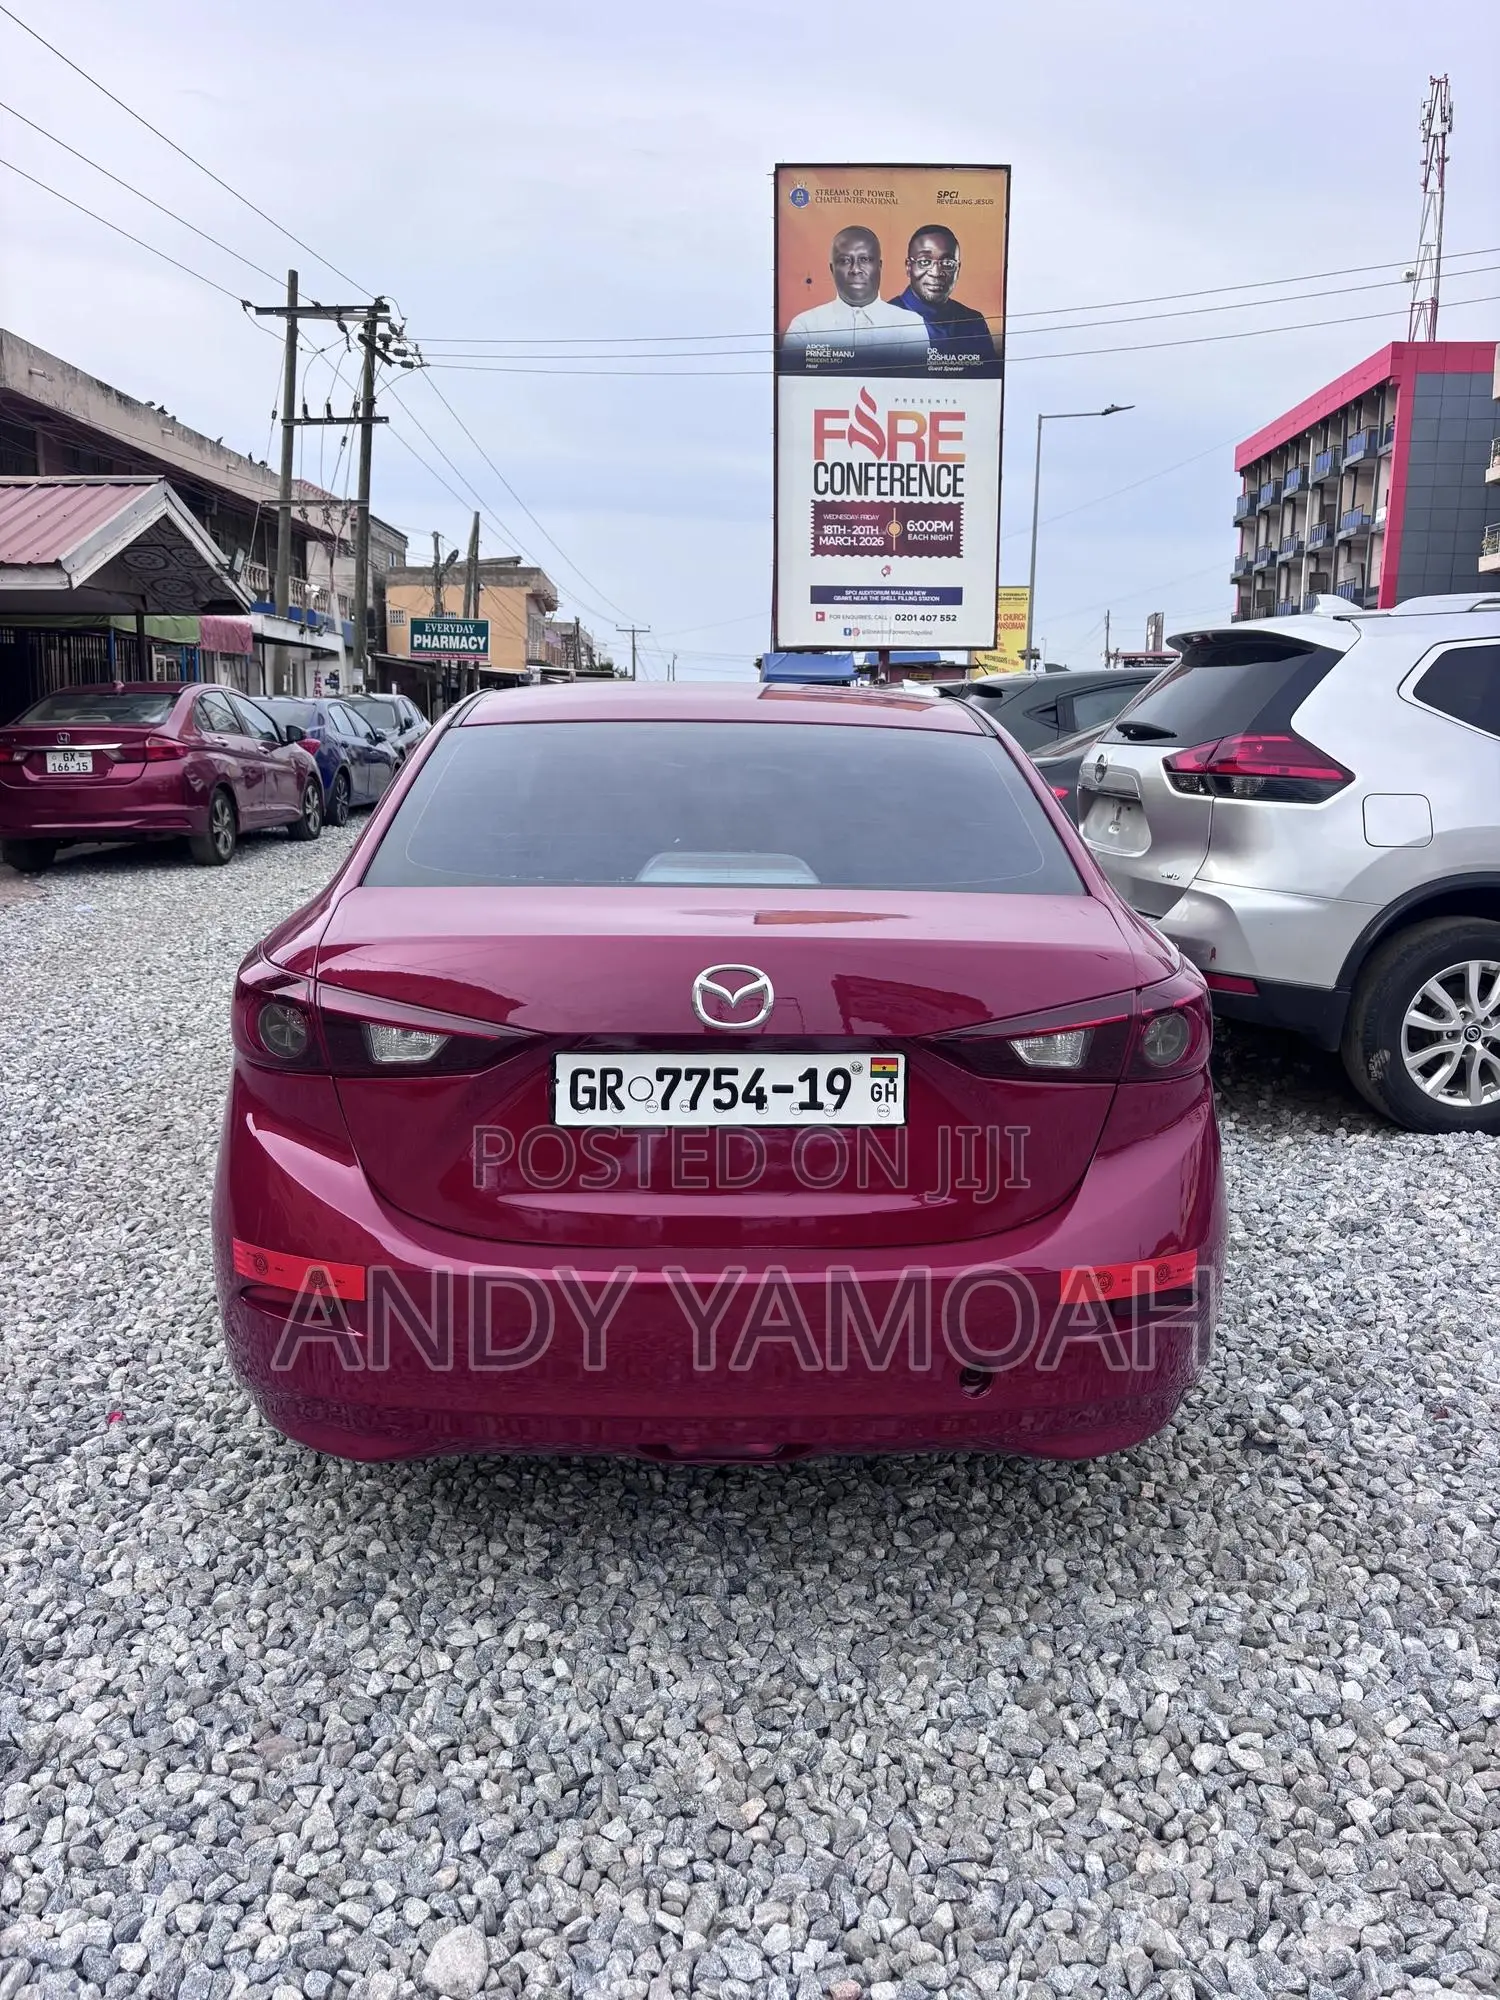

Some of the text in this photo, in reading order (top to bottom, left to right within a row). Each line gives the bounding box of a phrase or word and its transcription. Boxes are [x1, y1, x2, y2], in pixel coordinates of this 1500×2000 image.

[937, 190, 959, 198] SPCI
[844, 197, 898, 205] INTERNATIONAL
[806, 350, 855, 358] PRINCE MANU
[813, 461, 965, 498] CONFERENCE
[906, 520, 954, 533] 6:00PM
[859, 536, 885, 546] 2026
[907, 533, 929, 541] EACH
[1003, 613, 1027, 621] CHURCH
[424, 622, 476, 634] EVERYDAY
[413, 634, 486, 650] PHARMACY
[62, 752, 76, 762] GX
[51, 762, 88, 772] 166-15
[569, 1066, 852, 1112] GR 7754-19
[870, 1082, 898, 1104] GH
